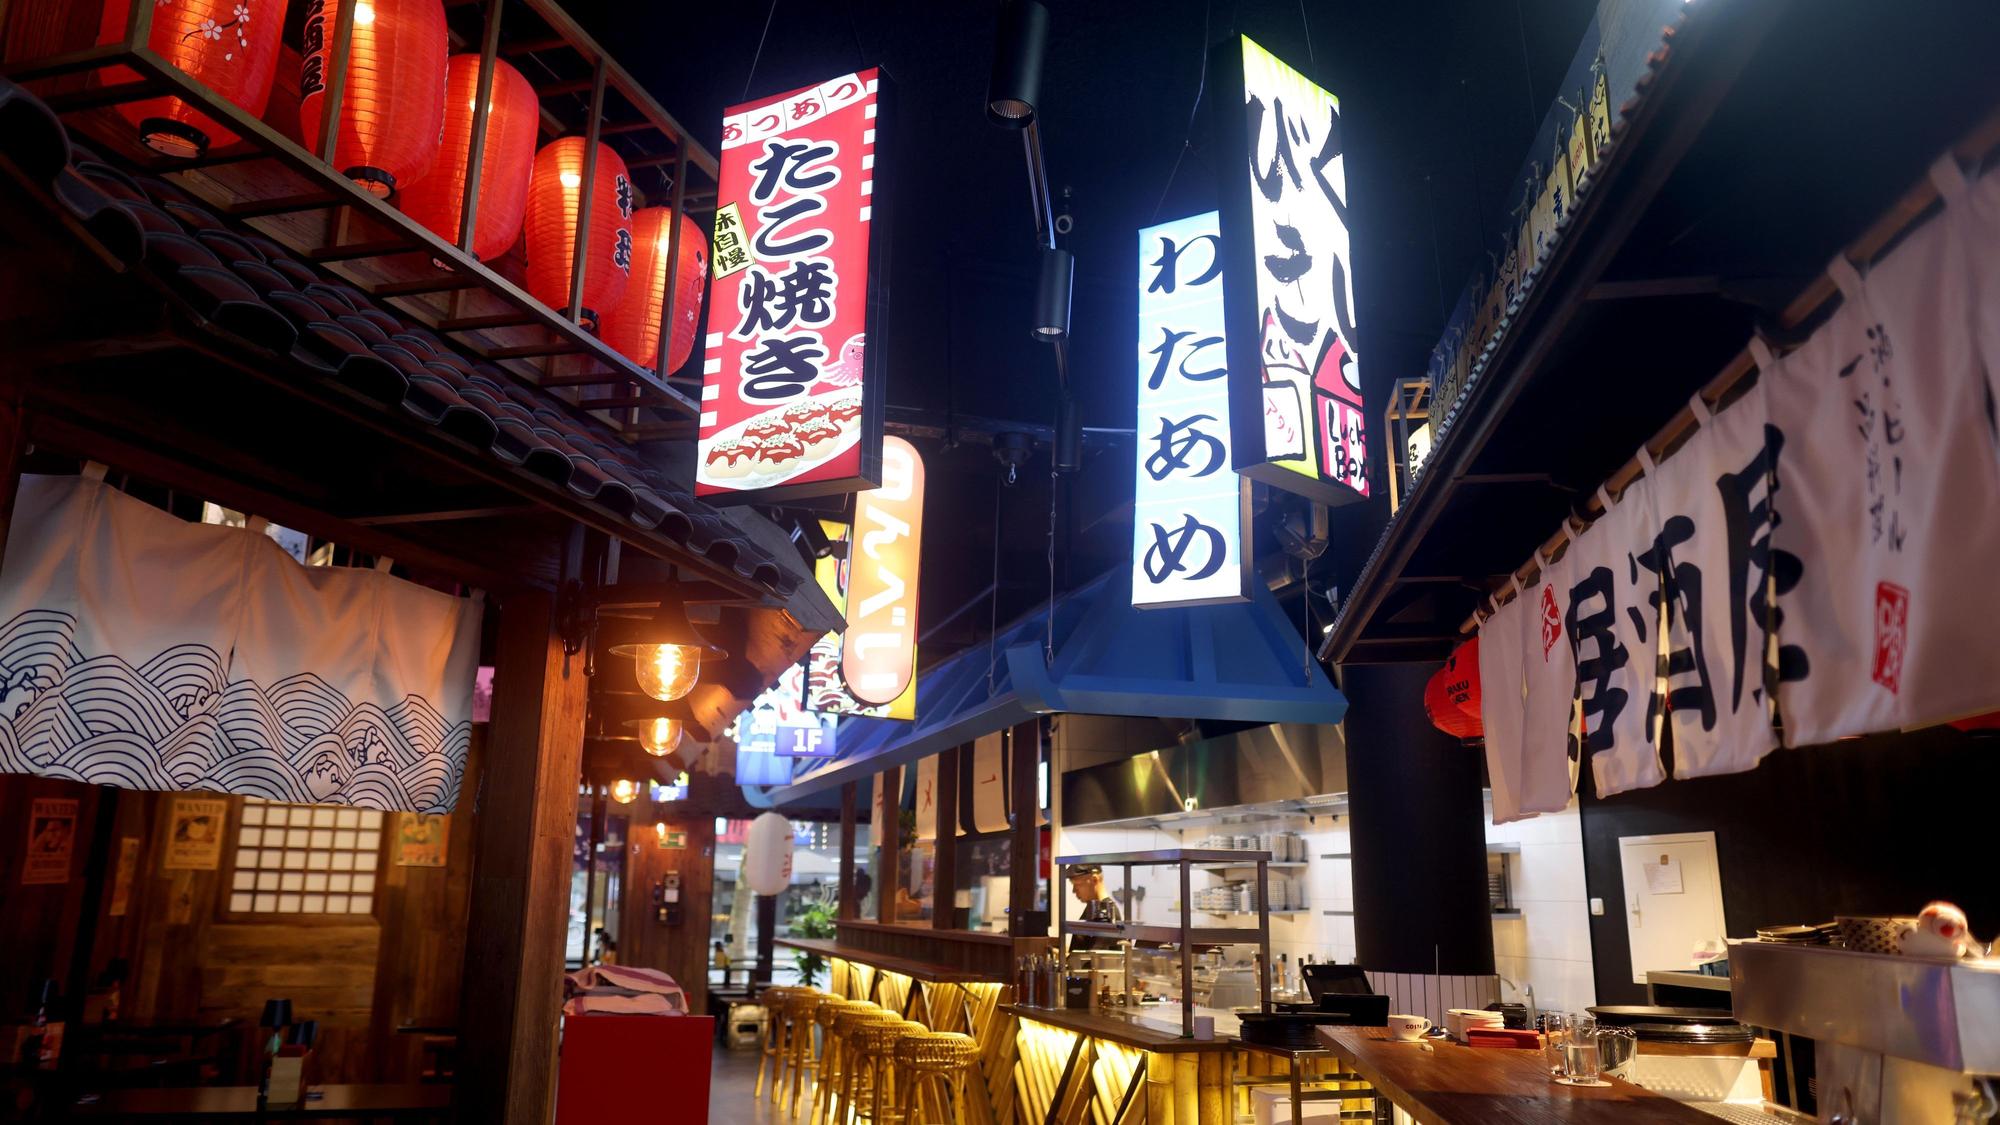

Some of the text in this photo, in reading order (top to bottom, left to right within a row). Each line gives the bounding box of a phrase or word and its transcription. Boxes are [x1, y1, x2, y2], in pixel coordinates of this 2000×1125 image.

[722, 82, 858, 141] あつあつ
[738, 142, 836, 400] たこ焼き
[1143, 234, 1227, 584] わたあめ
[1565, 423, 1809, 752] 居酒屋
[176, 802, 224, 813] WANTED
[792, 728, 823, 753] 1F
